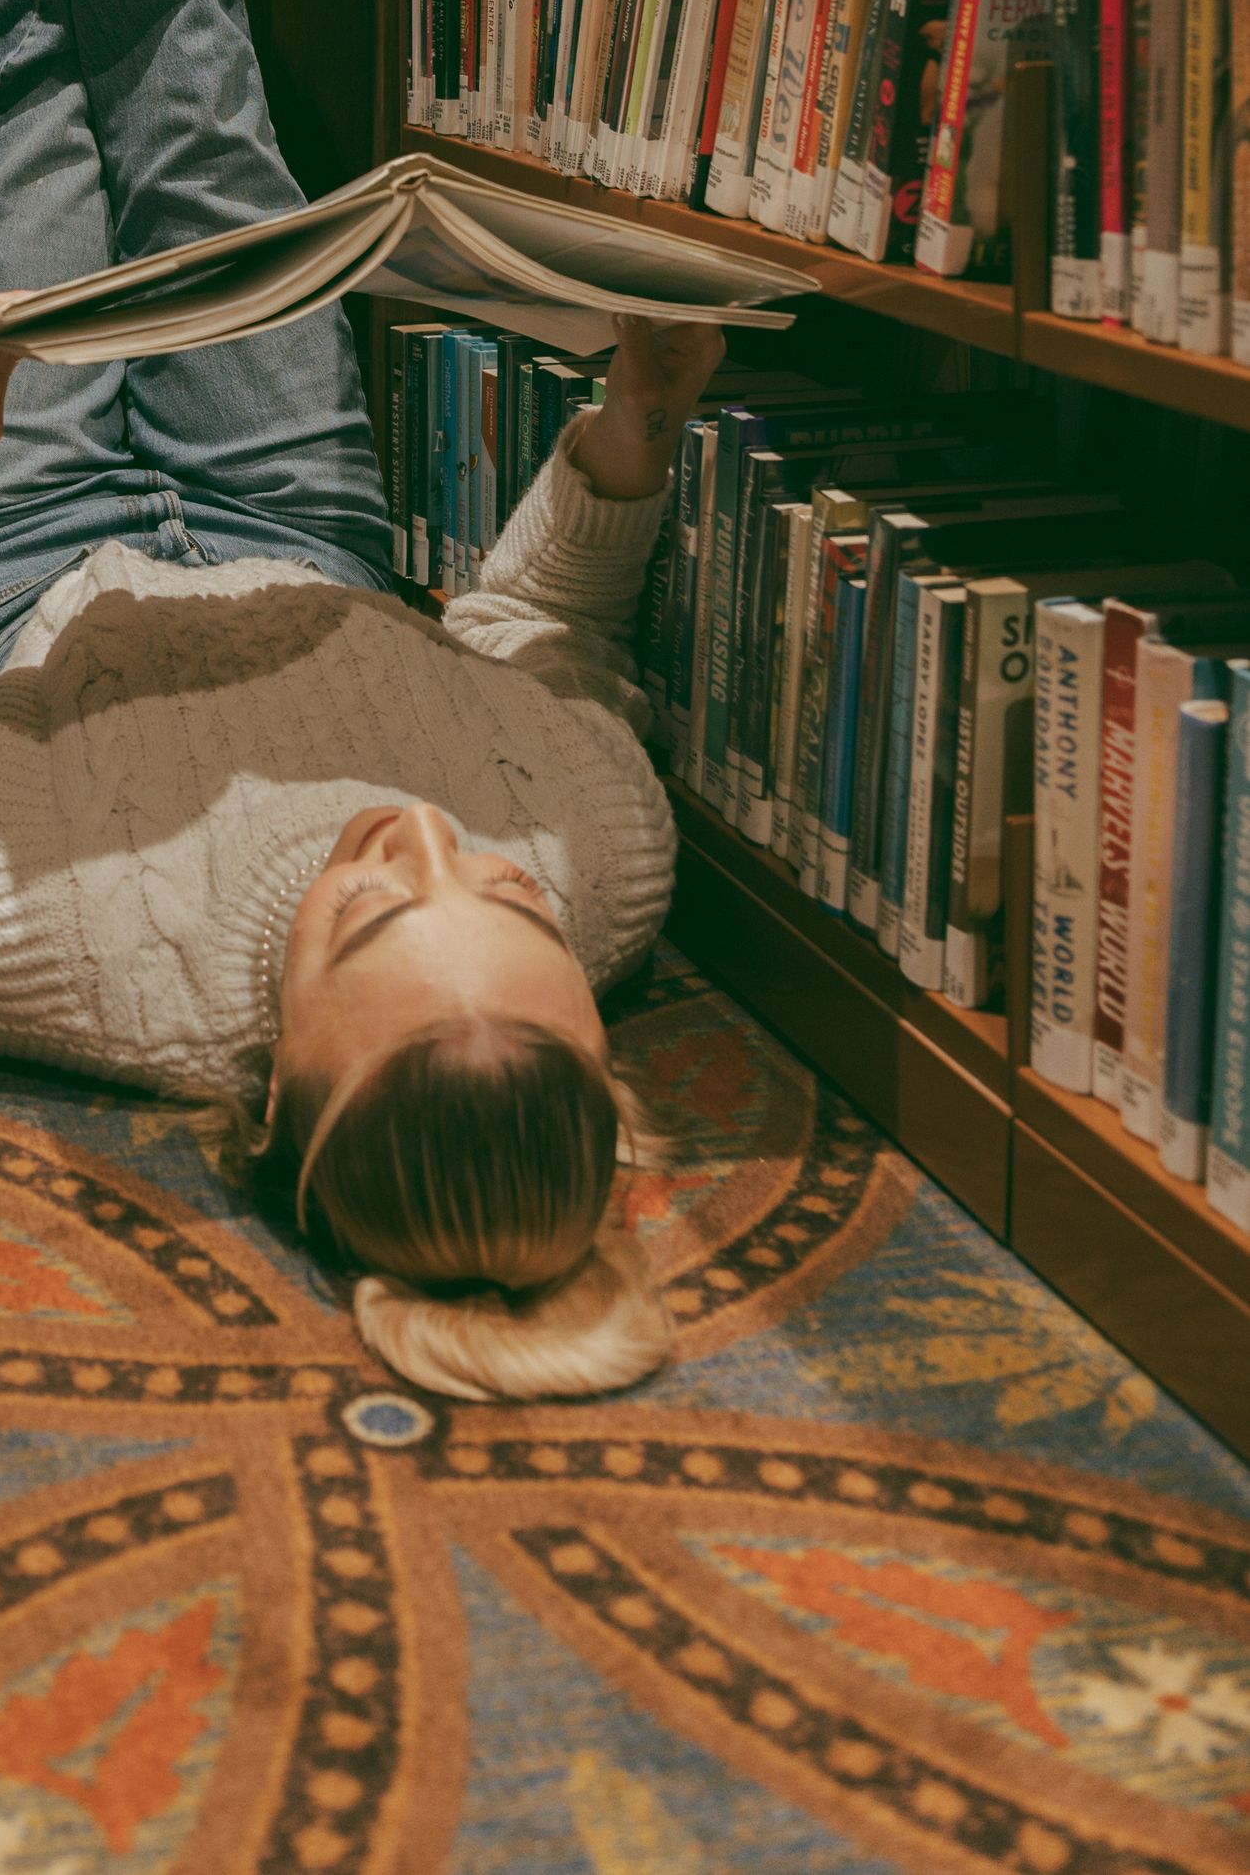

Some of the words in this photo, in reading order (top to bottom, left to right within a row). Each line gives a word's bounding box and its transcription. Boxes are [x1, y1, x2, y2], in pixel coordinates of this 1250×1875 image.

[769, 23, 781, 58] OINK
[804, 34, 820, 82] streetcar
[800, 85, 812, 122] named
[816, 48, 831, 102] WILSON
[1188, 80, 1202, 120] JOHN
[760, 97, 772, 140] DAVID
[796, 126, 807, 159] desire
[391, 392, 402, 454] MYSTERY
[521, 380, 531, 412] IRISH
[521, 414, 530, 462] COFFEE
[391, 459, 401, 515] STORIES
[678, 463, 693, 523] Dad's
[701, 511, 713, 550] From
[714, 511, 734, 610] PURPLE
[675, 551, 687, 605] Book
[699, 559, 712, 600] Sarah
[699, 604, 710, 619] to
[696, 627, 711, 687] Sydney
[711, 611, 730, 704] RISING
[920, 613, 933, 685] BARRY
[916, 693, 928, 761] LOPEZ
[955, 706, 973, 777] SISTER
[1037, 634, 1053, 790] BOURDAIN
[1056, 644, 1080, 801] ANTHONY
[950, 784, 969, 885] OUTSIDER
[1052, 914, 1076, 1026] WORLD
[1097, 900, 1131, 1023] WORLD
[1227, 938, 1247, 1023] STARS
[1222, 1028, 1242, 1146] EUROPE
